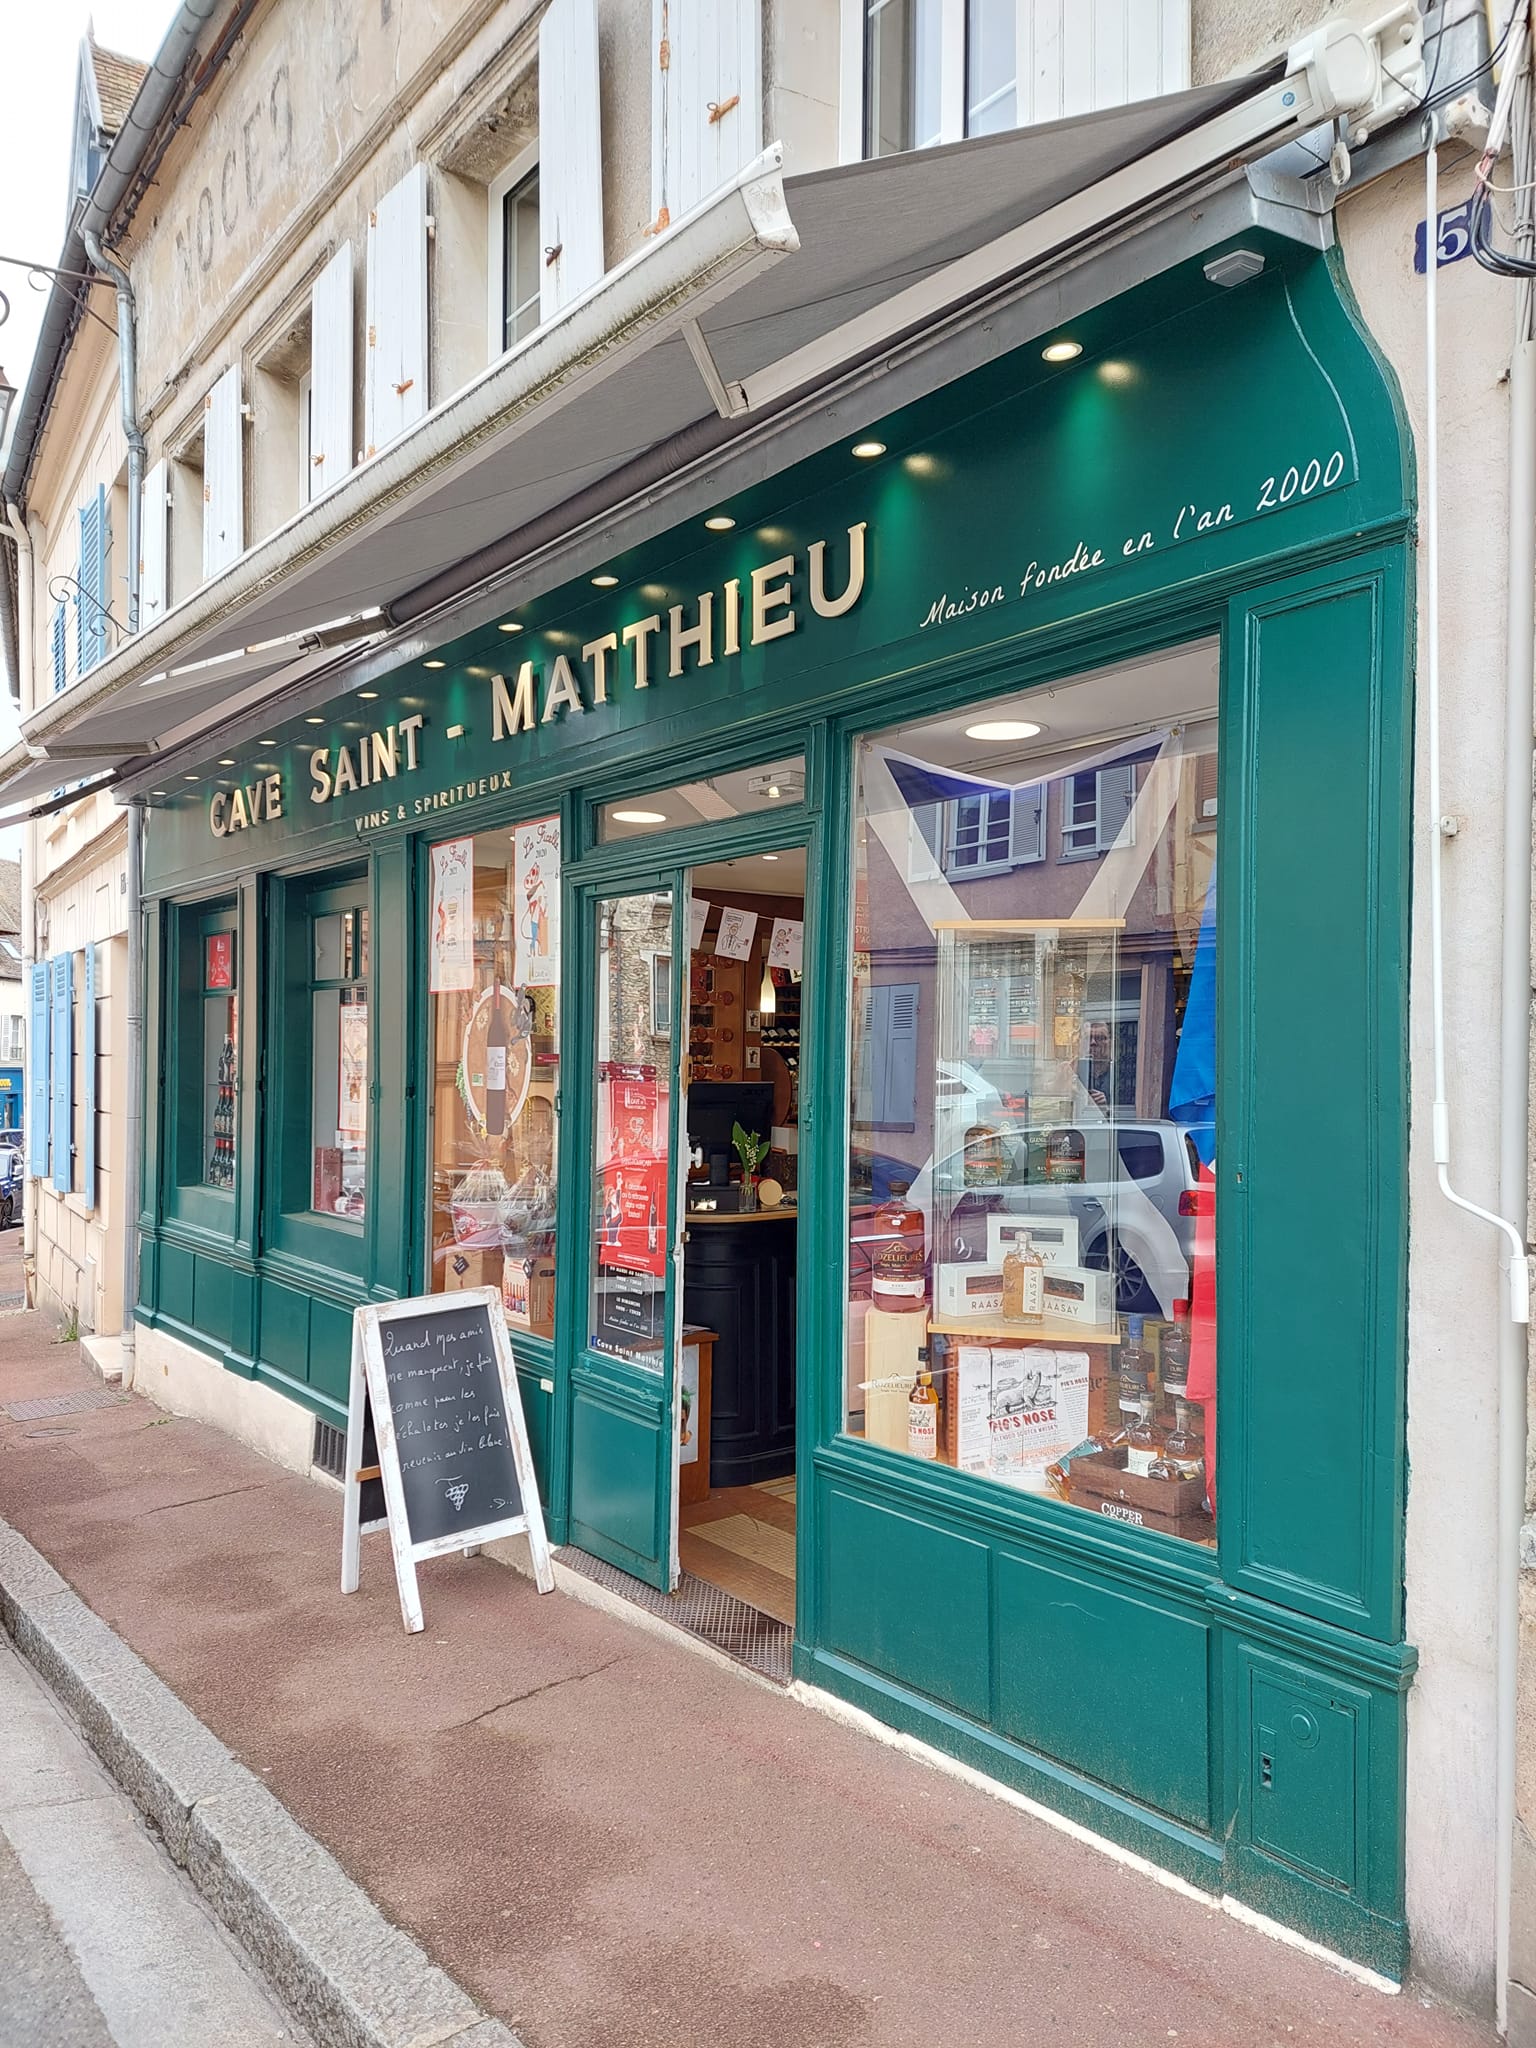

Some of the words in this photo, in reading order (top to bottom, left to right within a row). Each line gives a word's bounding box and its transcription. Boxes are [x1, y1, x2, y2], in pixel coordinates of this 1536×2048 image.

[1437, 206, 1469, 260] 5
[919, 585, 1005, 628] Maison
[1020, 541, 1106, 597] fondée
[1123, 531, 1155, 556] en
[1173, 504, 1235, 540] l'an
[1256, 451, 1345, 512] 2000
[209, 773, 283, 837] CAVE
[309, 714, 423, 803] SAINT
[491, 522, 868, 742] MATTHIEU
[355, 810, 390, 832] VINS
[397, 805, 407, 820] &
[414, 770, 512, 815] SPIRITUEUX
[971, 1300, 1004, 1310] RAASA
[1028, 1269, 1038, 1312] RAASAY
[384, 1329, 431, 1357] Quand
[459, 1323, 484, 1341] amis
[597, 1338, 613, 1351] Cave
[615, 1344, 633, 1358] Saint
[635, 1351, 664, 1370] Matthie
[1022, 1408, 1056, 1426] NOSE
[1101, 1502, 1144, 1525] COPPER
